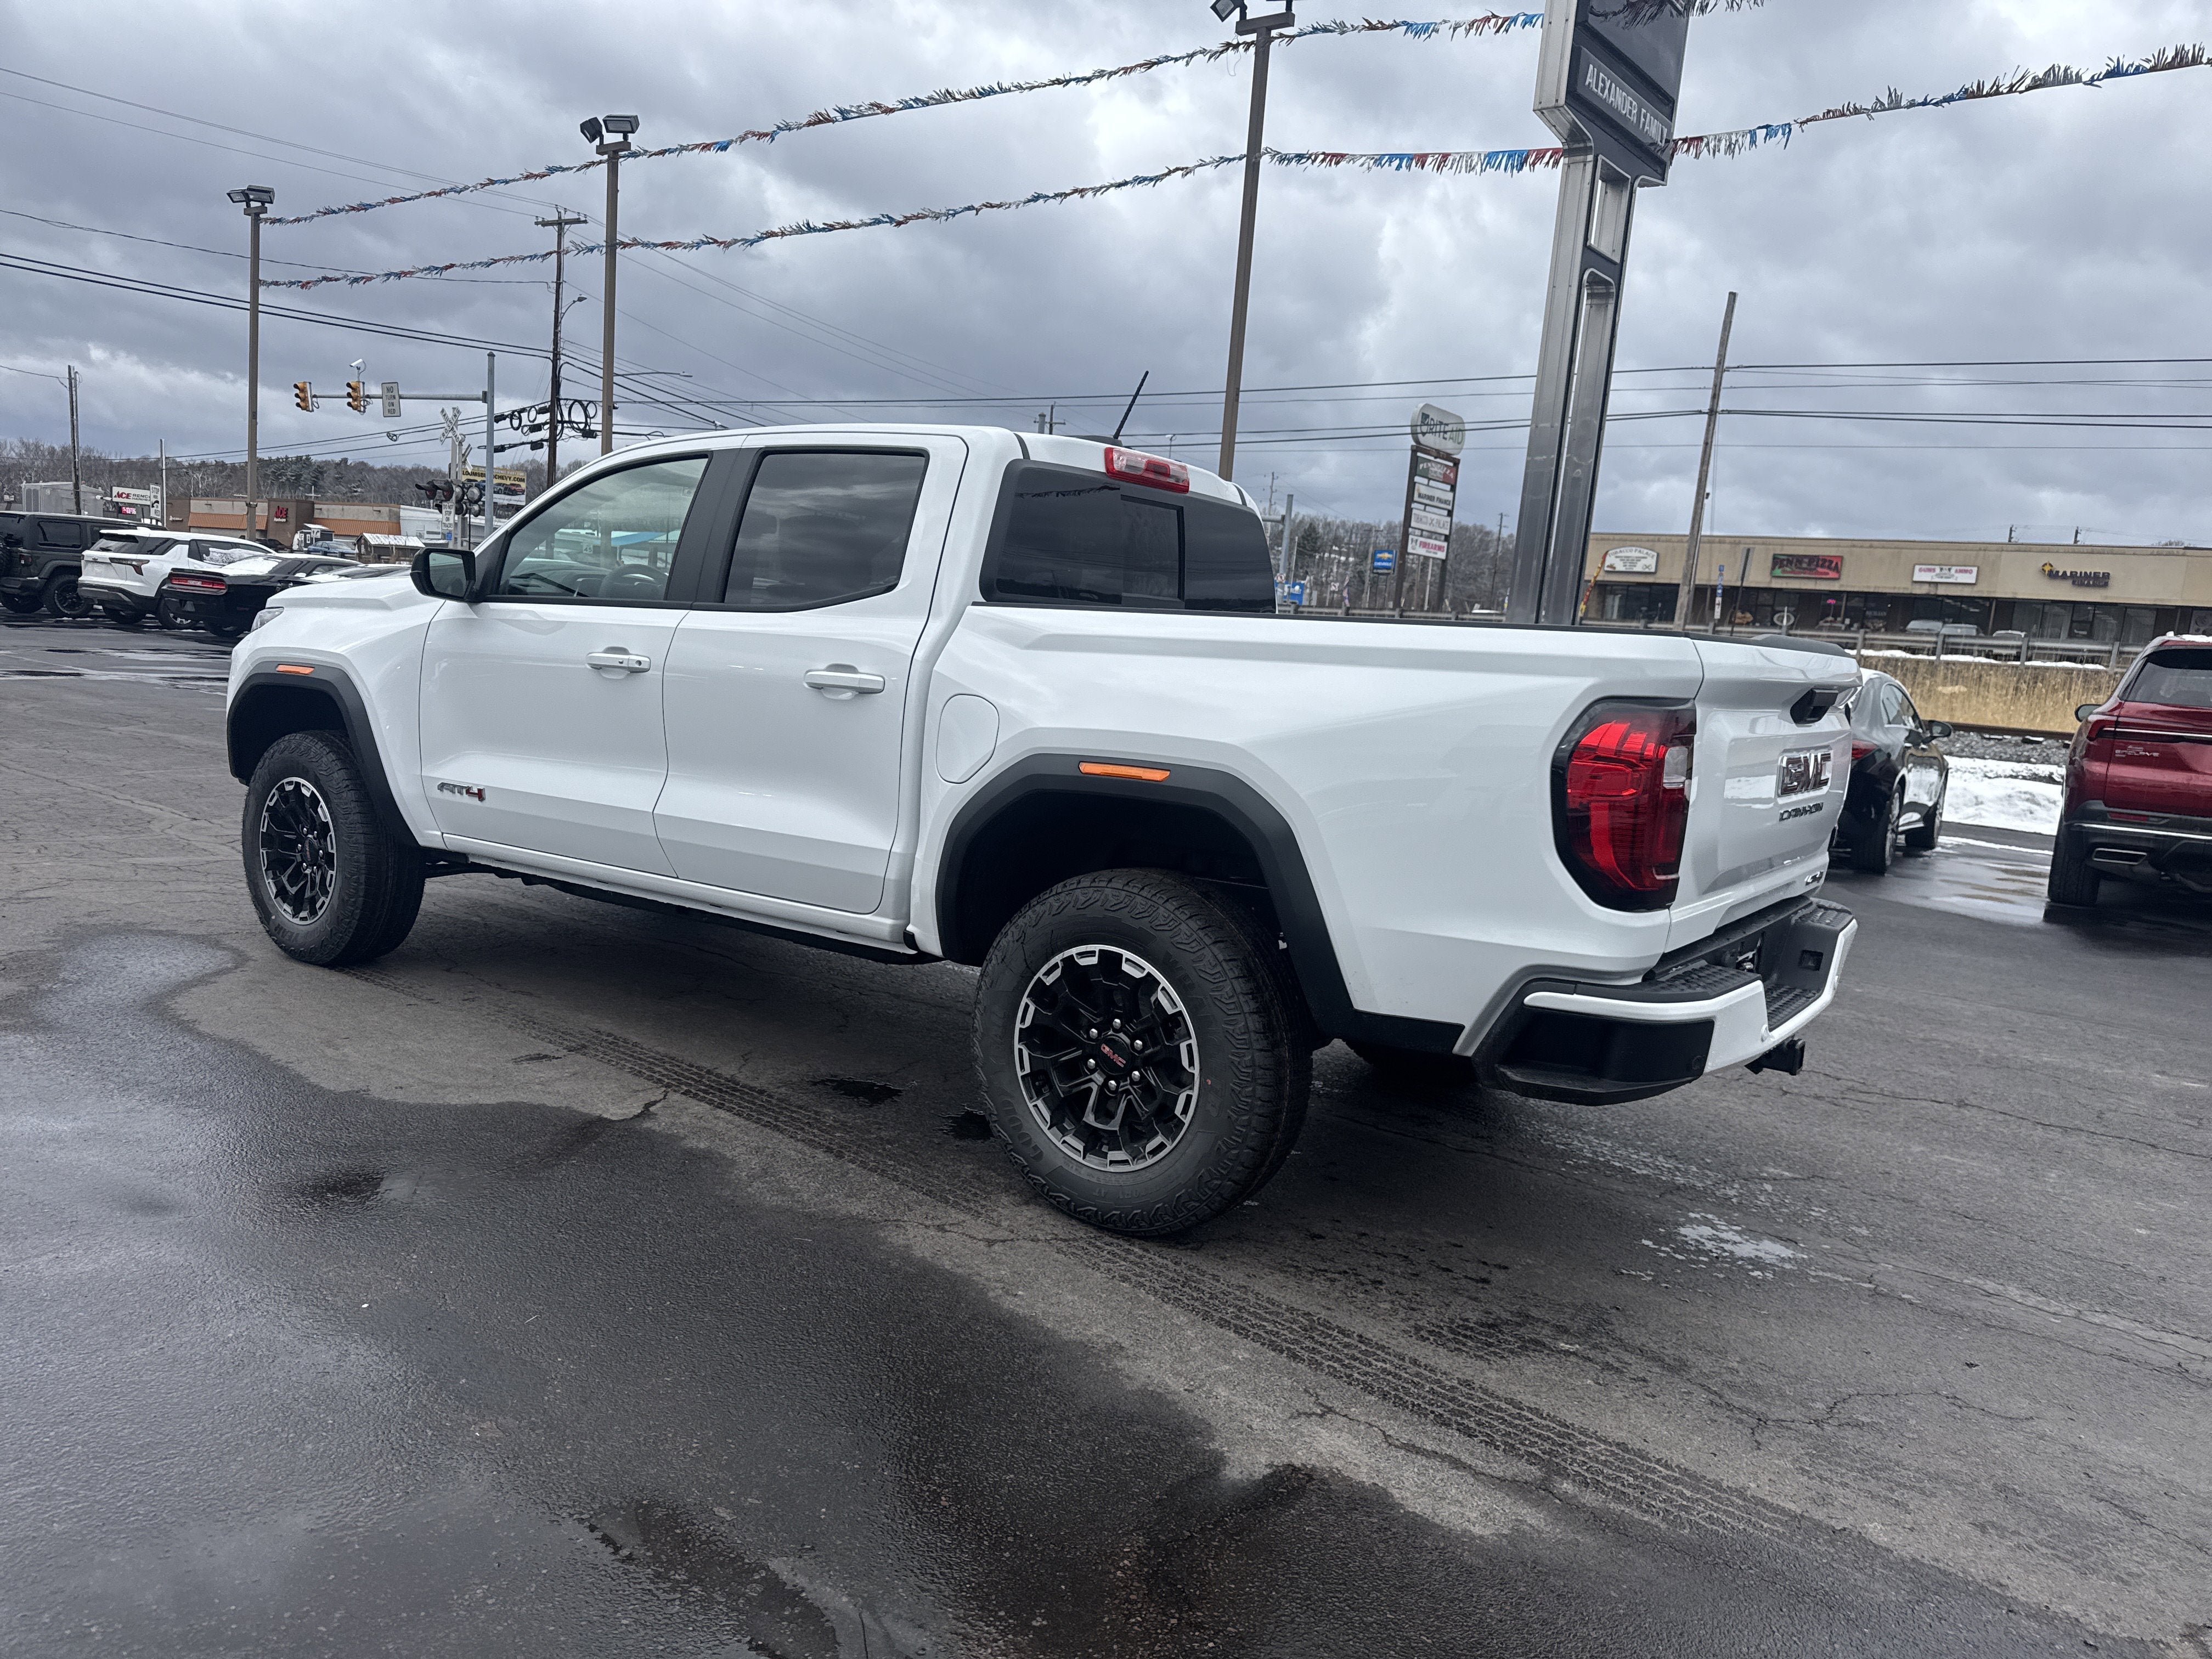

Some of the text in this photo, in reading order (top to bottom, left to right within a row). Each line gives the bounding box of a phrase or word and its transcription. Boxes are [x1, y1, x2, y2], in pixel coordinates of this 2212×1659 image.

[1585, 64, 1667, 146] ALEXANDER FAMILY
[439, 408, 460, 442] CROSSING
[1429, 417, 1464, 445] RITE AID
[114, 490, 132, 500] ACE
[151, 486, 160, 494] STOP
[274, 505, 289, 518] ACE
[1608, 549, 1655, 558] TOBACCO PALACE
[2048, 570, 2111, 579] MARINER
[2071, 579, 2109, 588] FINANCE
[1779, 752, 1832, 796] GMC
[1779, 802, 1824, 822] CANYON
[1101, 1043, 1126, 1068] GMC
